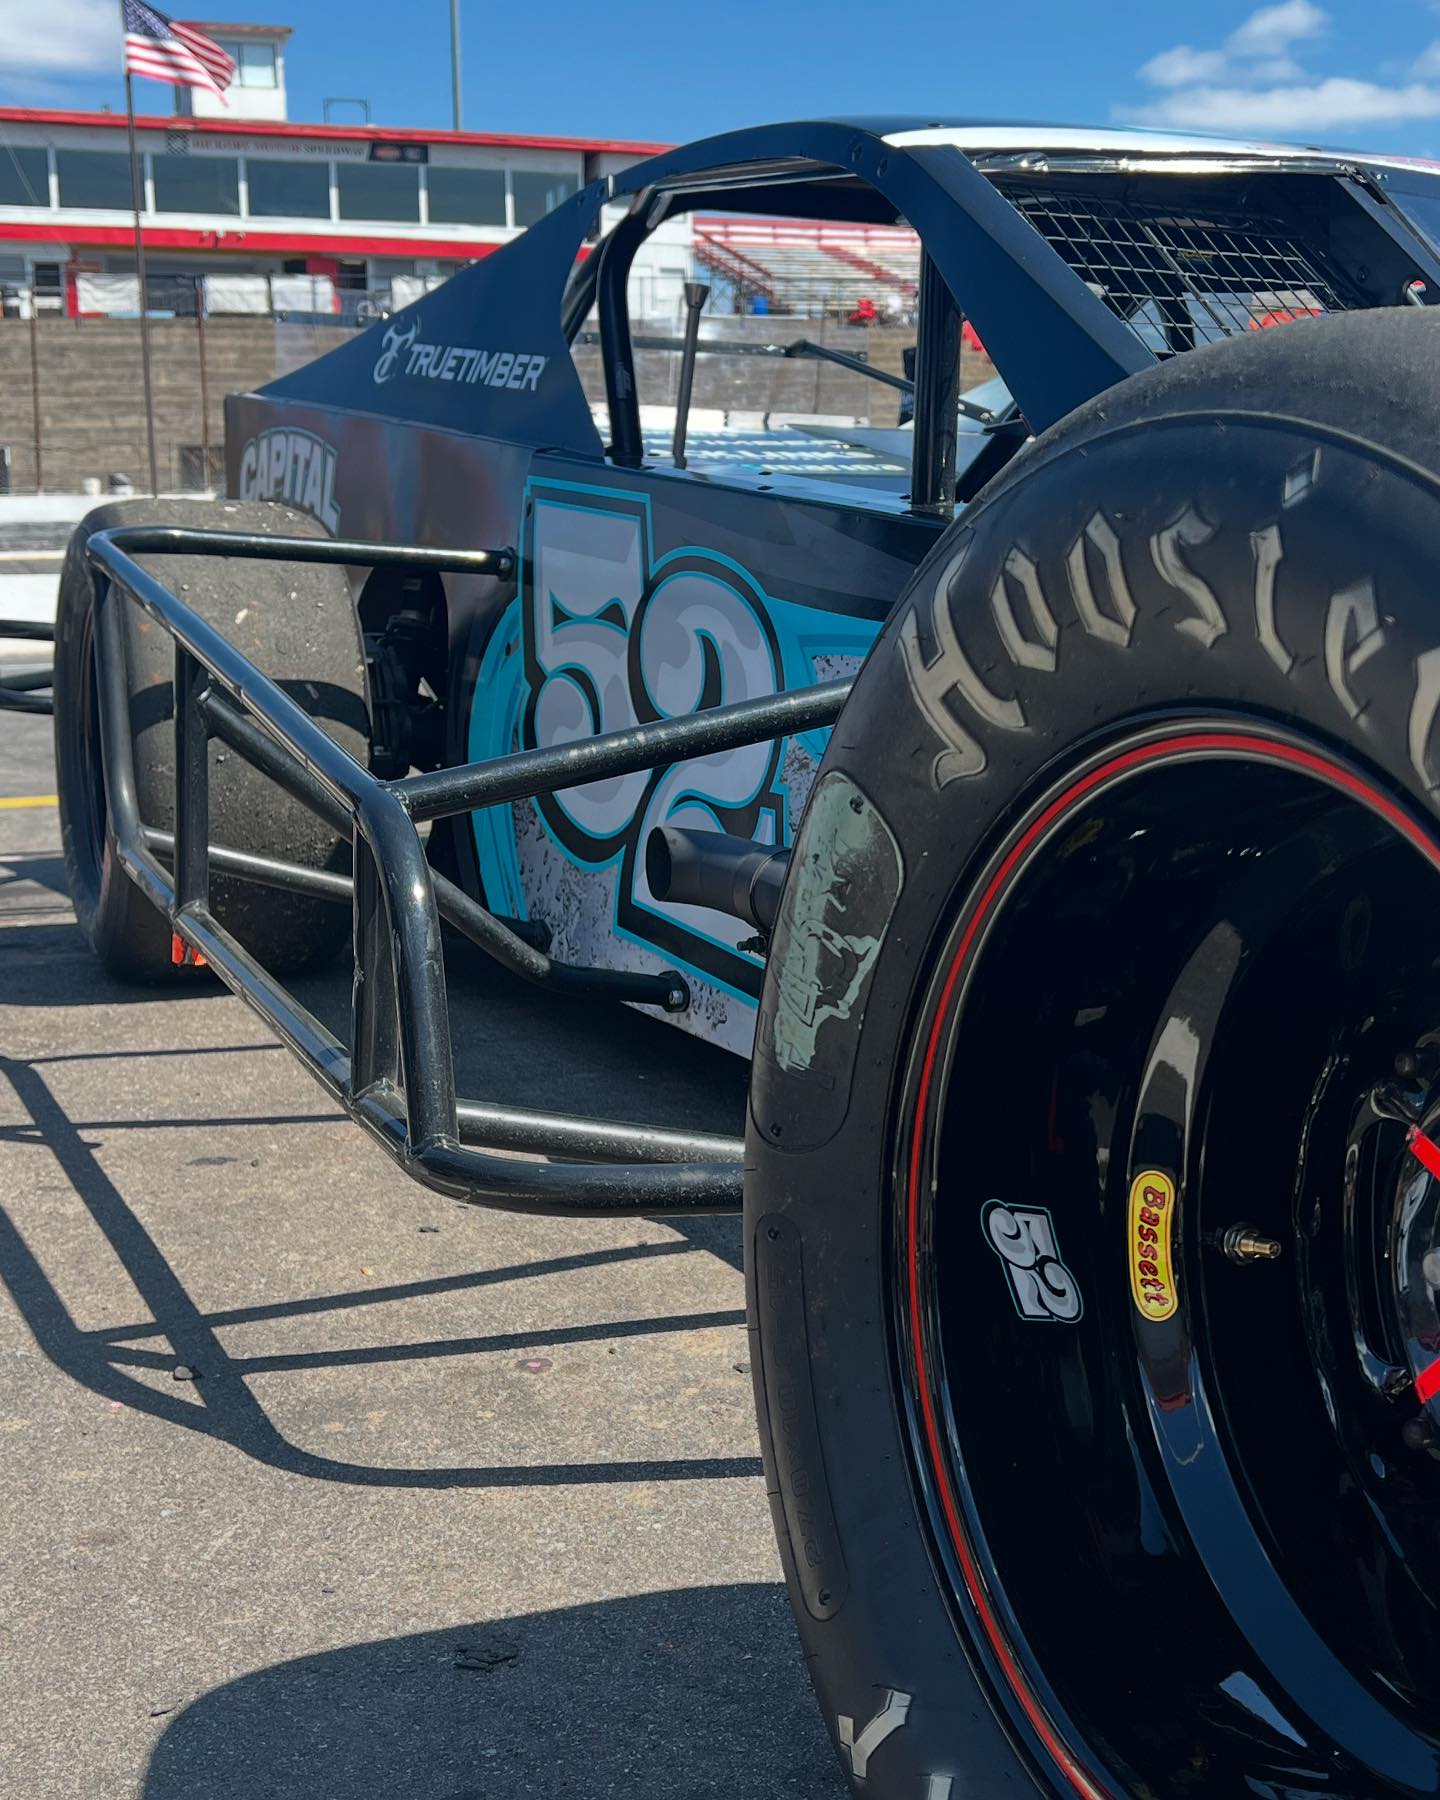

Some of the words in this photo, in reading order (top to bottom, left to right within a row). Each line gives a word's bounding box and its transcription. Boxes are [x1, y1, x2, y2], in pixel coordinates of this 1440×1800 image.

[404, 342, 548, 392] TRUETIMBER
[240, 430, 338, 538] CAPITAL
[526, 488, 788, 980] 52
[983, 1201, 1082, 1322] 52
[1137, 1185, 1170, 1307] Bassett
